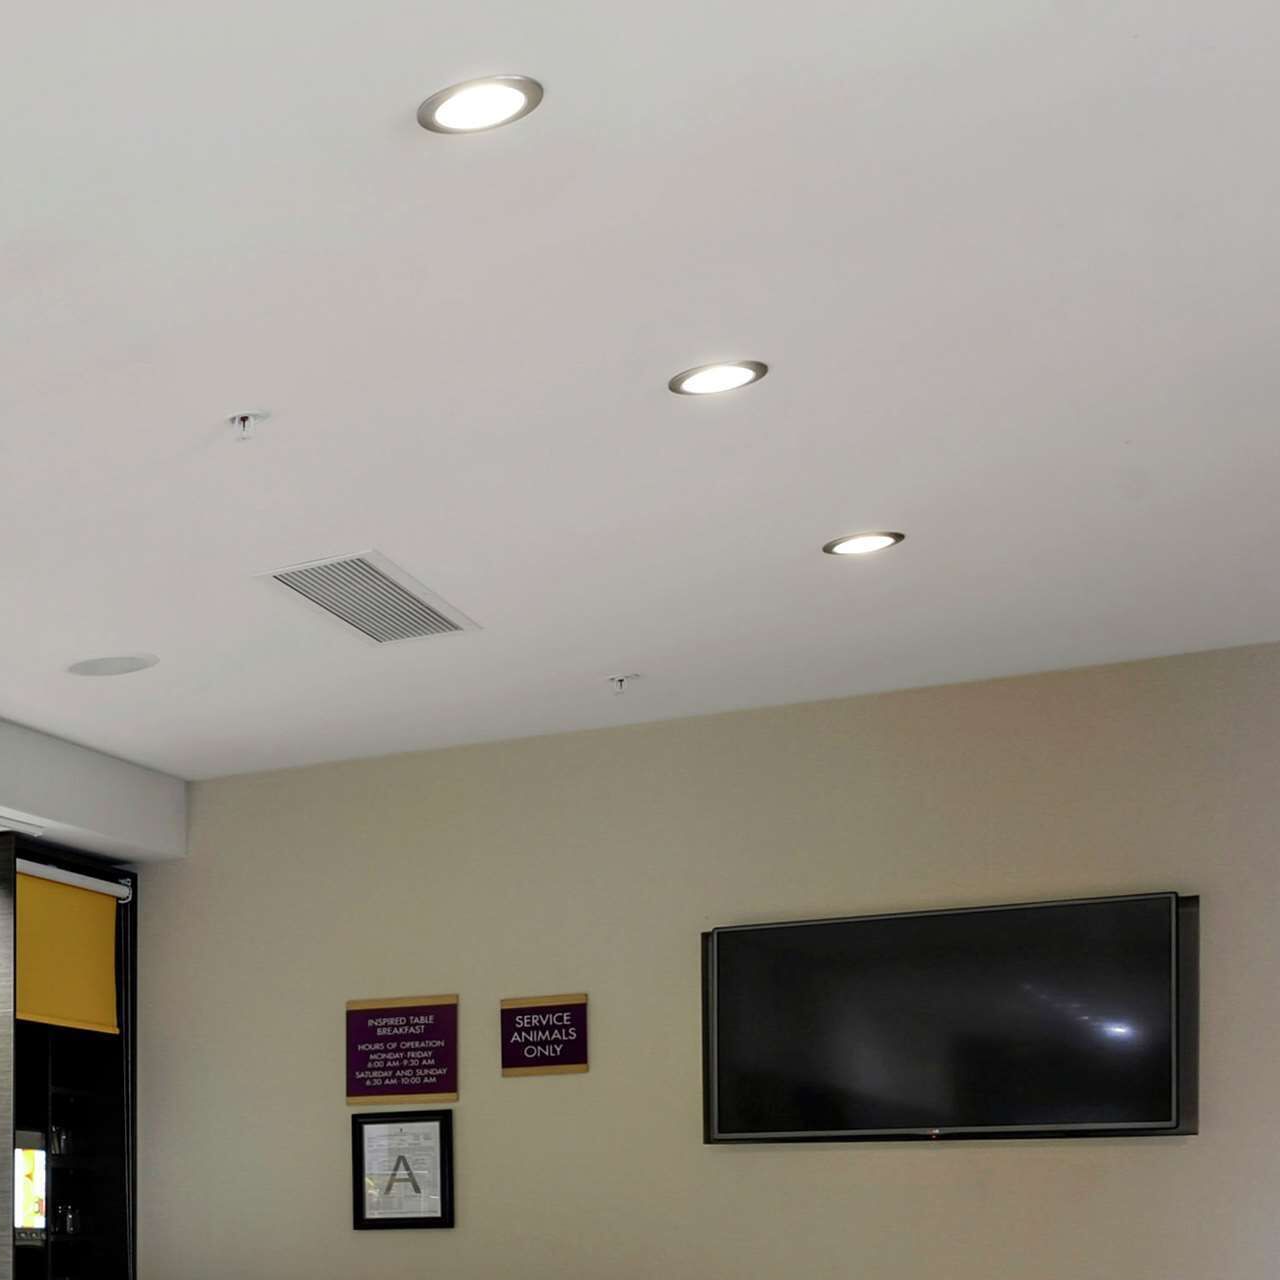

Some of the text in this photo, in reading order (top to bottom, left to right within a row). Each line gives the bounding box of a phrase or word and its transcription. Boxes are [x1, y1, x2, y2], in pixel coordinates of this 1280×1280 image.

[368, 1015, 434, 1026] INSPIRED TABLE
[515, 1012, 571, 1028] SERVICE
[376, 1025, 425, 1035] BREAKFAST
[510, 1027, 577, 1043] ANIMALS
[358, 1043, 385, 1051] HOURS
[400, 1040, 445, 1049] OPERATION
[524, 1044, 564, 1058] ONLY
[355, 1067, 448, 1079] SATURDAY AND SUNDAY
[384, 1155, 421, 1195] A
